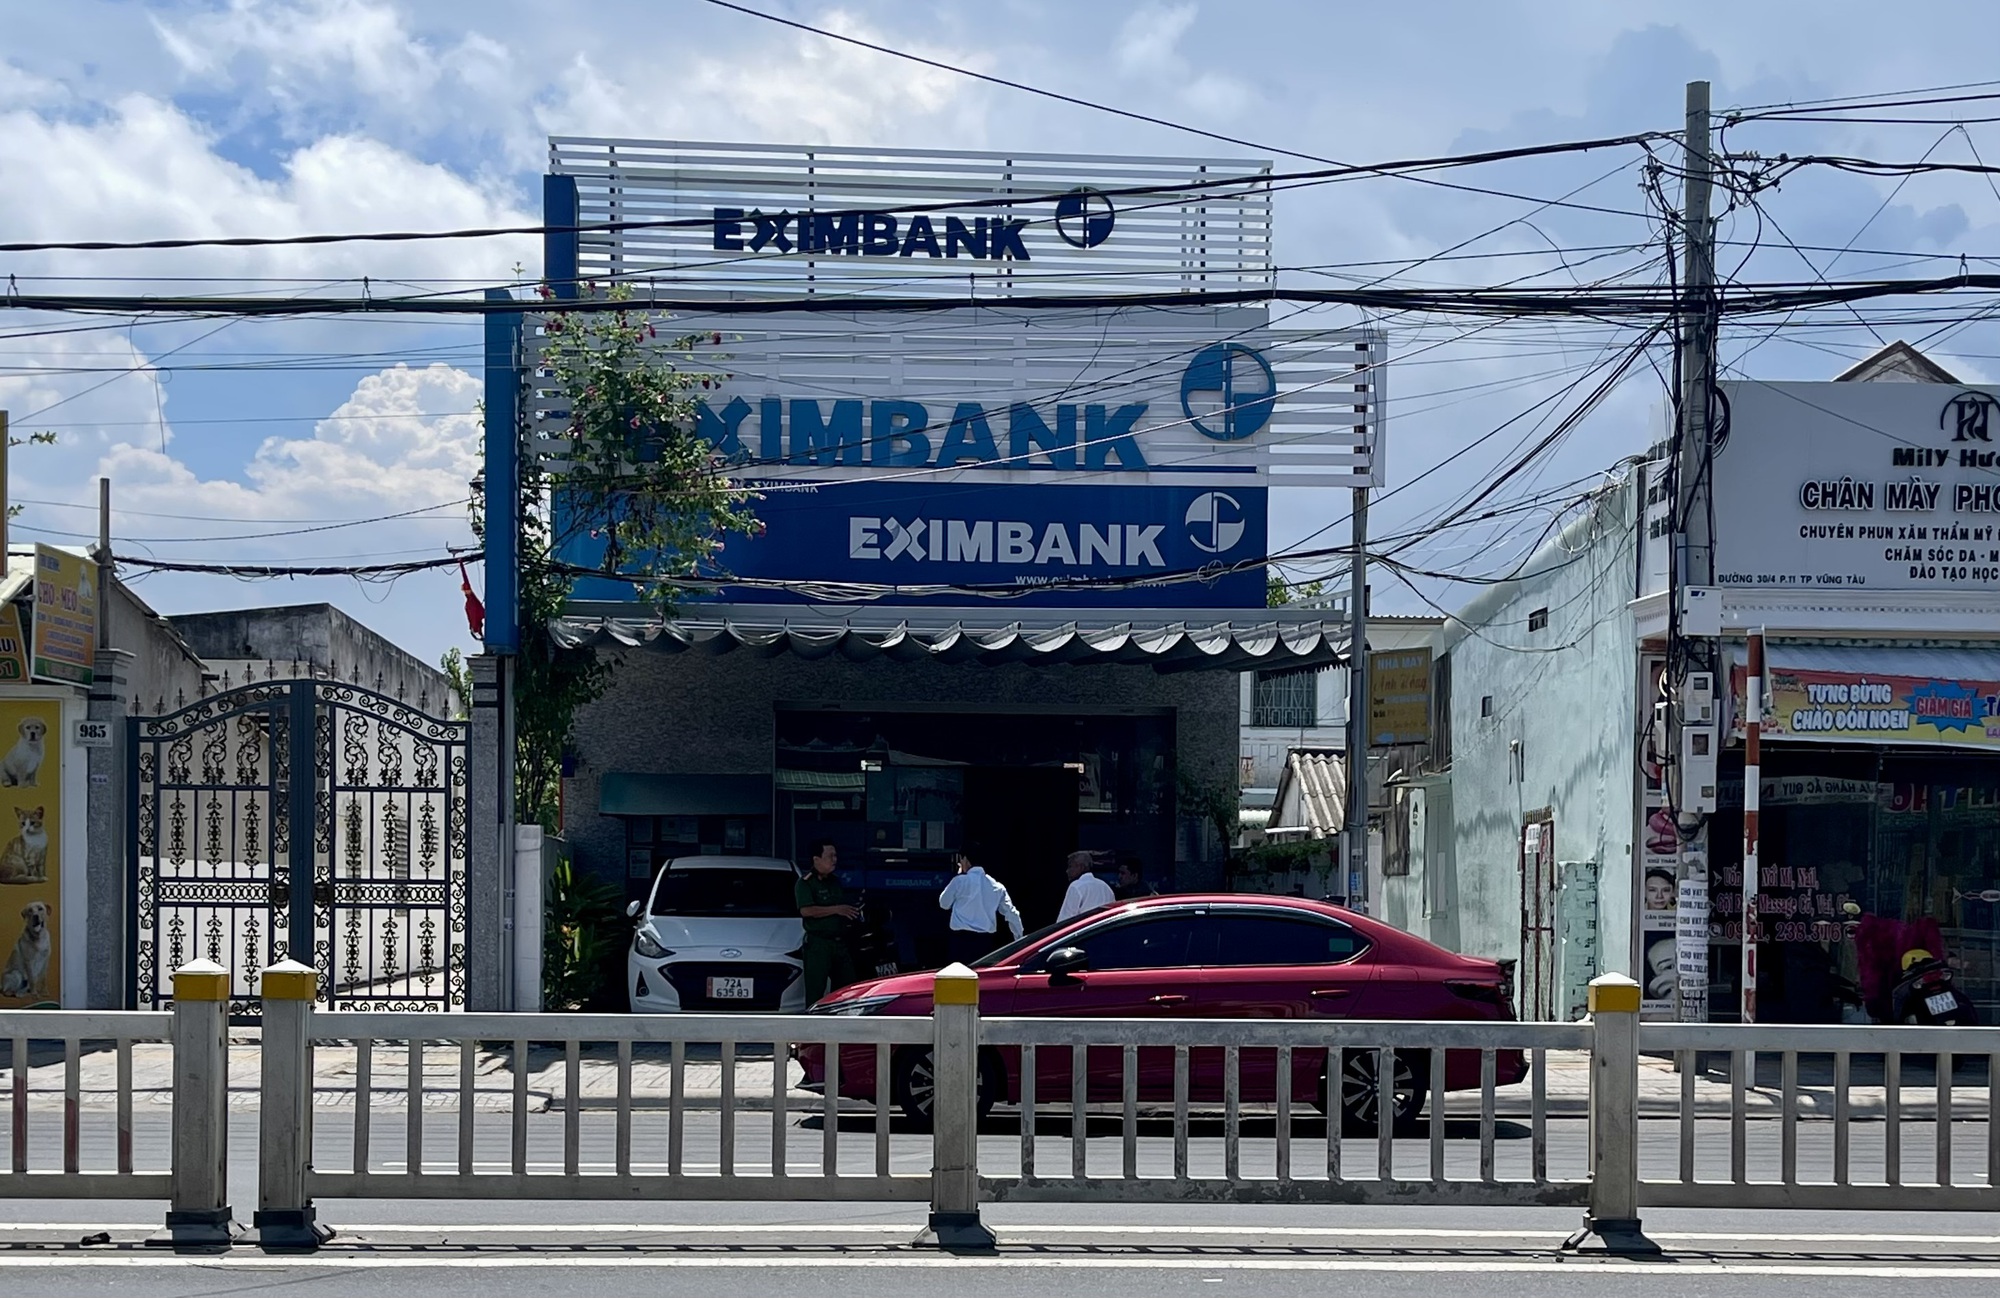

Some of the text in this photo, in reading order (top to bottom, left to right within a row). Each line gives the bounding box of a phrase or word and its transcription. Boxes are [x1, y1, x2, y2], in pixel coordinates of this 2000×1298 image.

[714, 207, 1031, 260] EXIMBANK
[1892, 447, 1950, 467] Mily
[1801, 475, 1875, 511] CHÂN
[1885, 475, 1941, 512] MÀY
[1800, 520, 1994, 541] CHUYÊN PHUN XĂM THẨM MỸ
[849, 516, 1166, 567] EXIMBANK
[1885, 545, 1922, 561] CHĂM
[1928, 545, 1954, 562] SÓC
[1959, 550, 1976, 562] DA
[1757, 574, 1775, 584] 30/4
[1780, 574, 1796, 584] P.11
[1800, 575, 1812, 584] TP
[1816, 573, 1842, 584] VŨNG
[1846, 573, 1866, 585] TÀU
[1910, 563, 1999, 583] ĐÀO TẠO HỌC
[1916, 690, 1973, 719] GIẢM GIÁ
[1791, 706, 1833, 731] CHÀO
[1835, 705, 1868, 730] ĐÓN
[80, 724, 106, 738] 985
[724, 978, 742, 988] 72A
